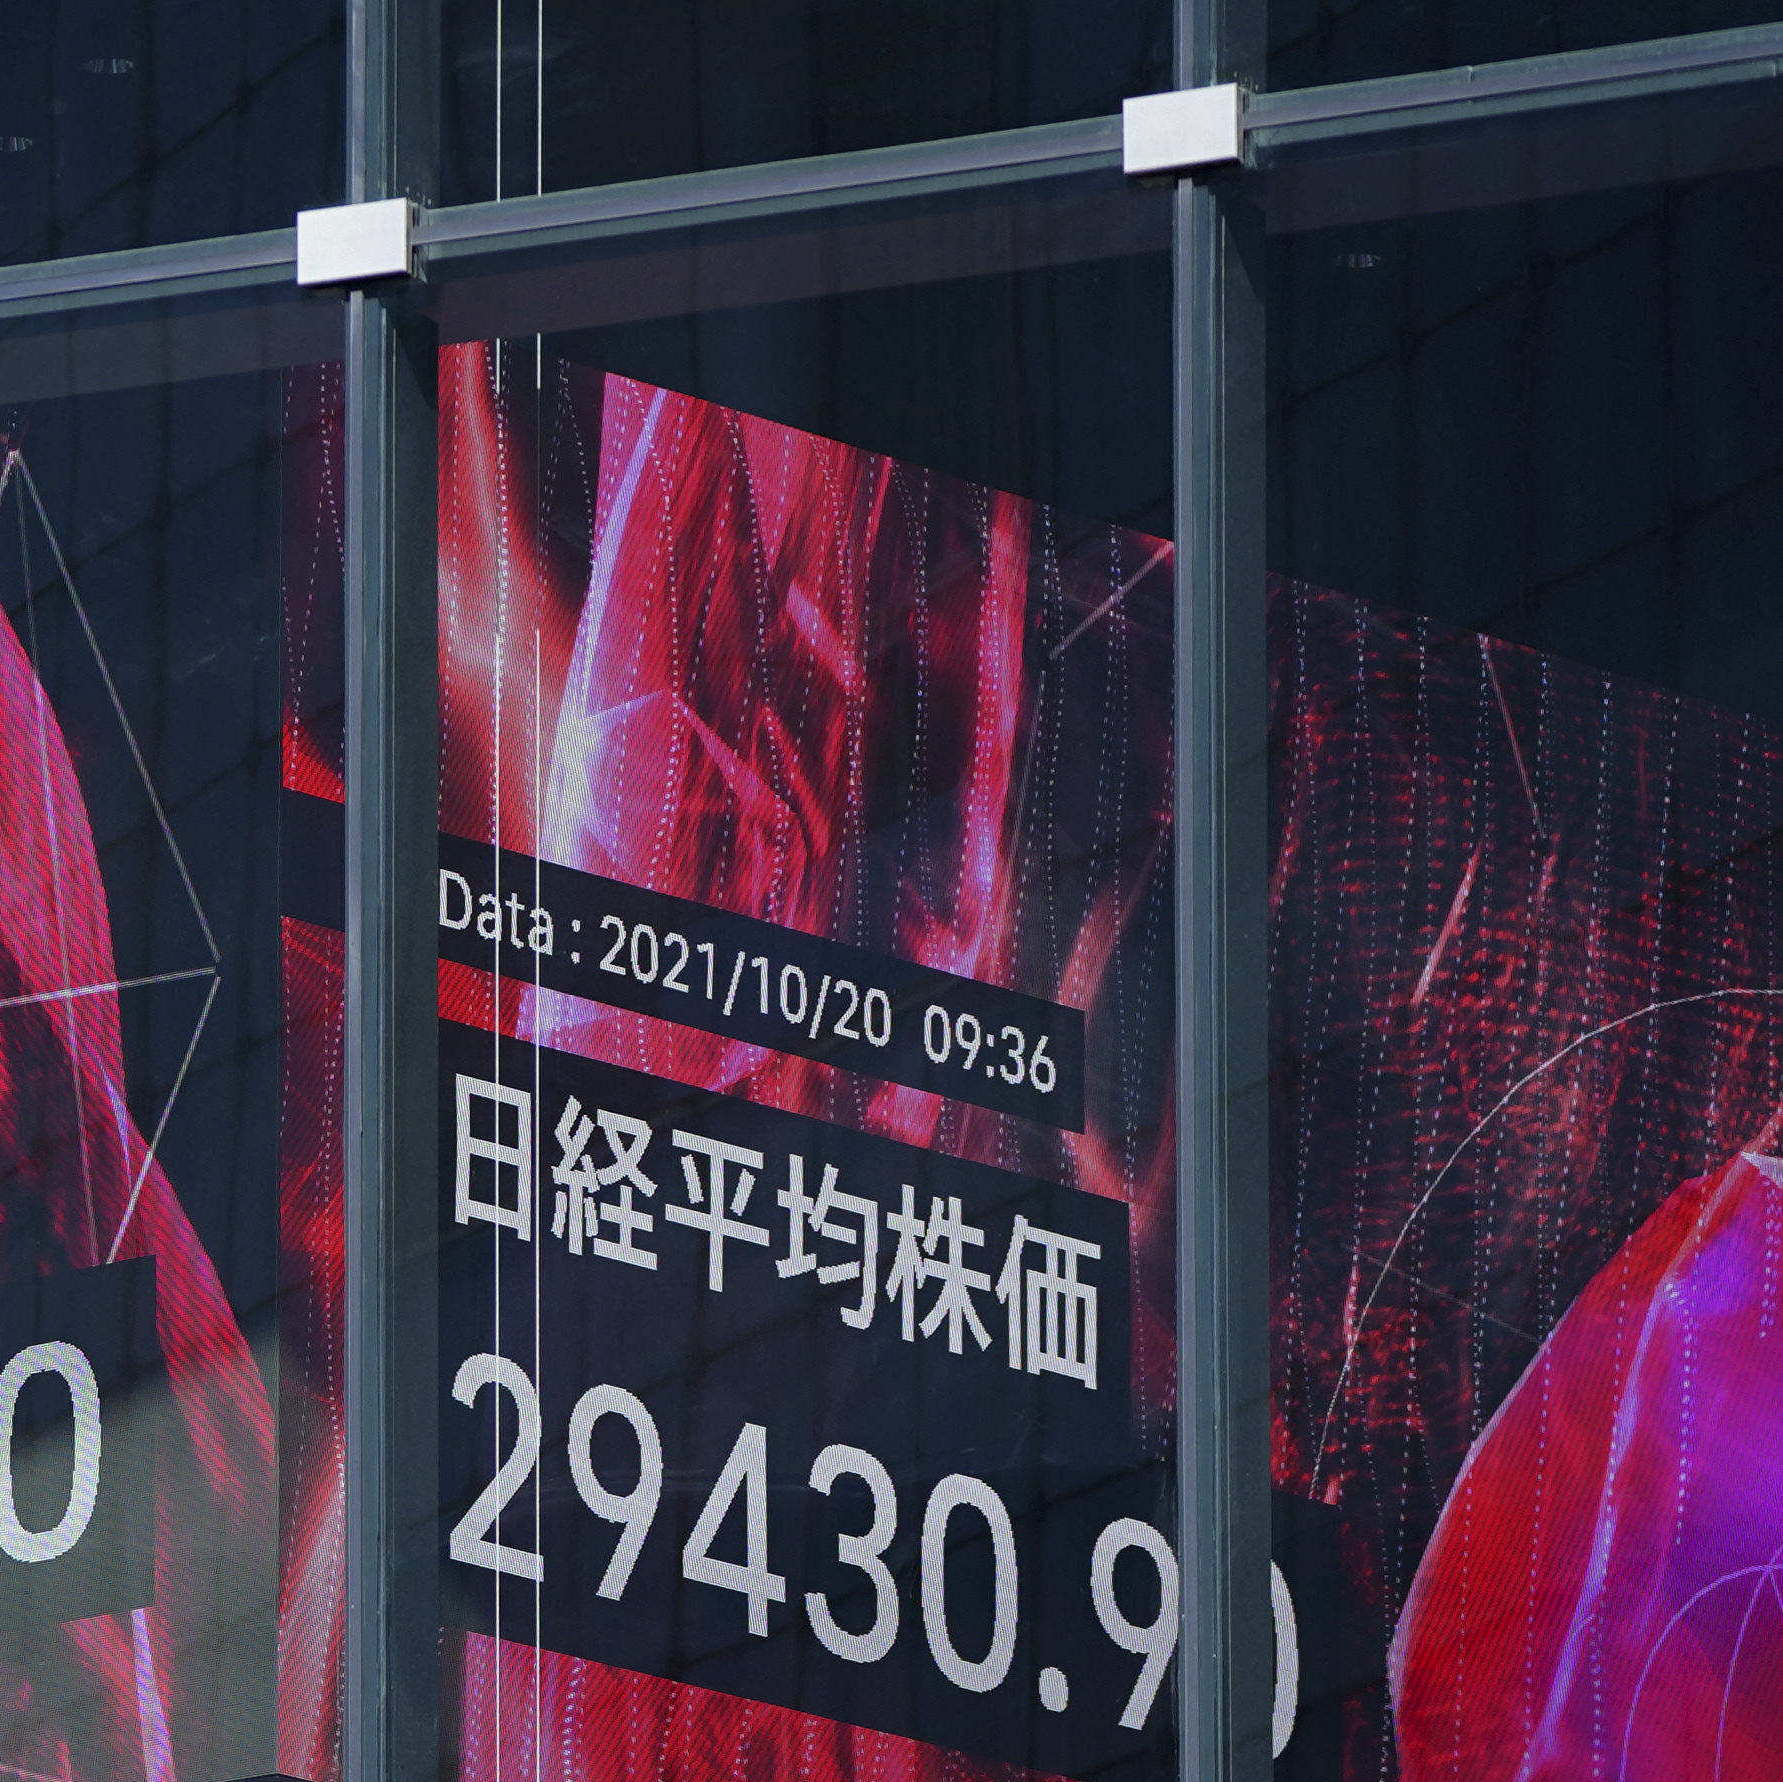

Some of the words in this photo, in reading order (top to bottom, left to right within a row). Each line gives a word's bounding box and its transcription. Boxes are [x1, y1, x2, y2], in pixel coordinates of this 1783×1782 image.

[438, 868, 553, 956] Data
[598, 914, 892, 1047] 2021/10/20
[923, 1004, 1057, 1094] 09:36
[453, 1071, 1103, 1391] 日経平均株価
[448, 1352, 1299, 1762] 29430.9
